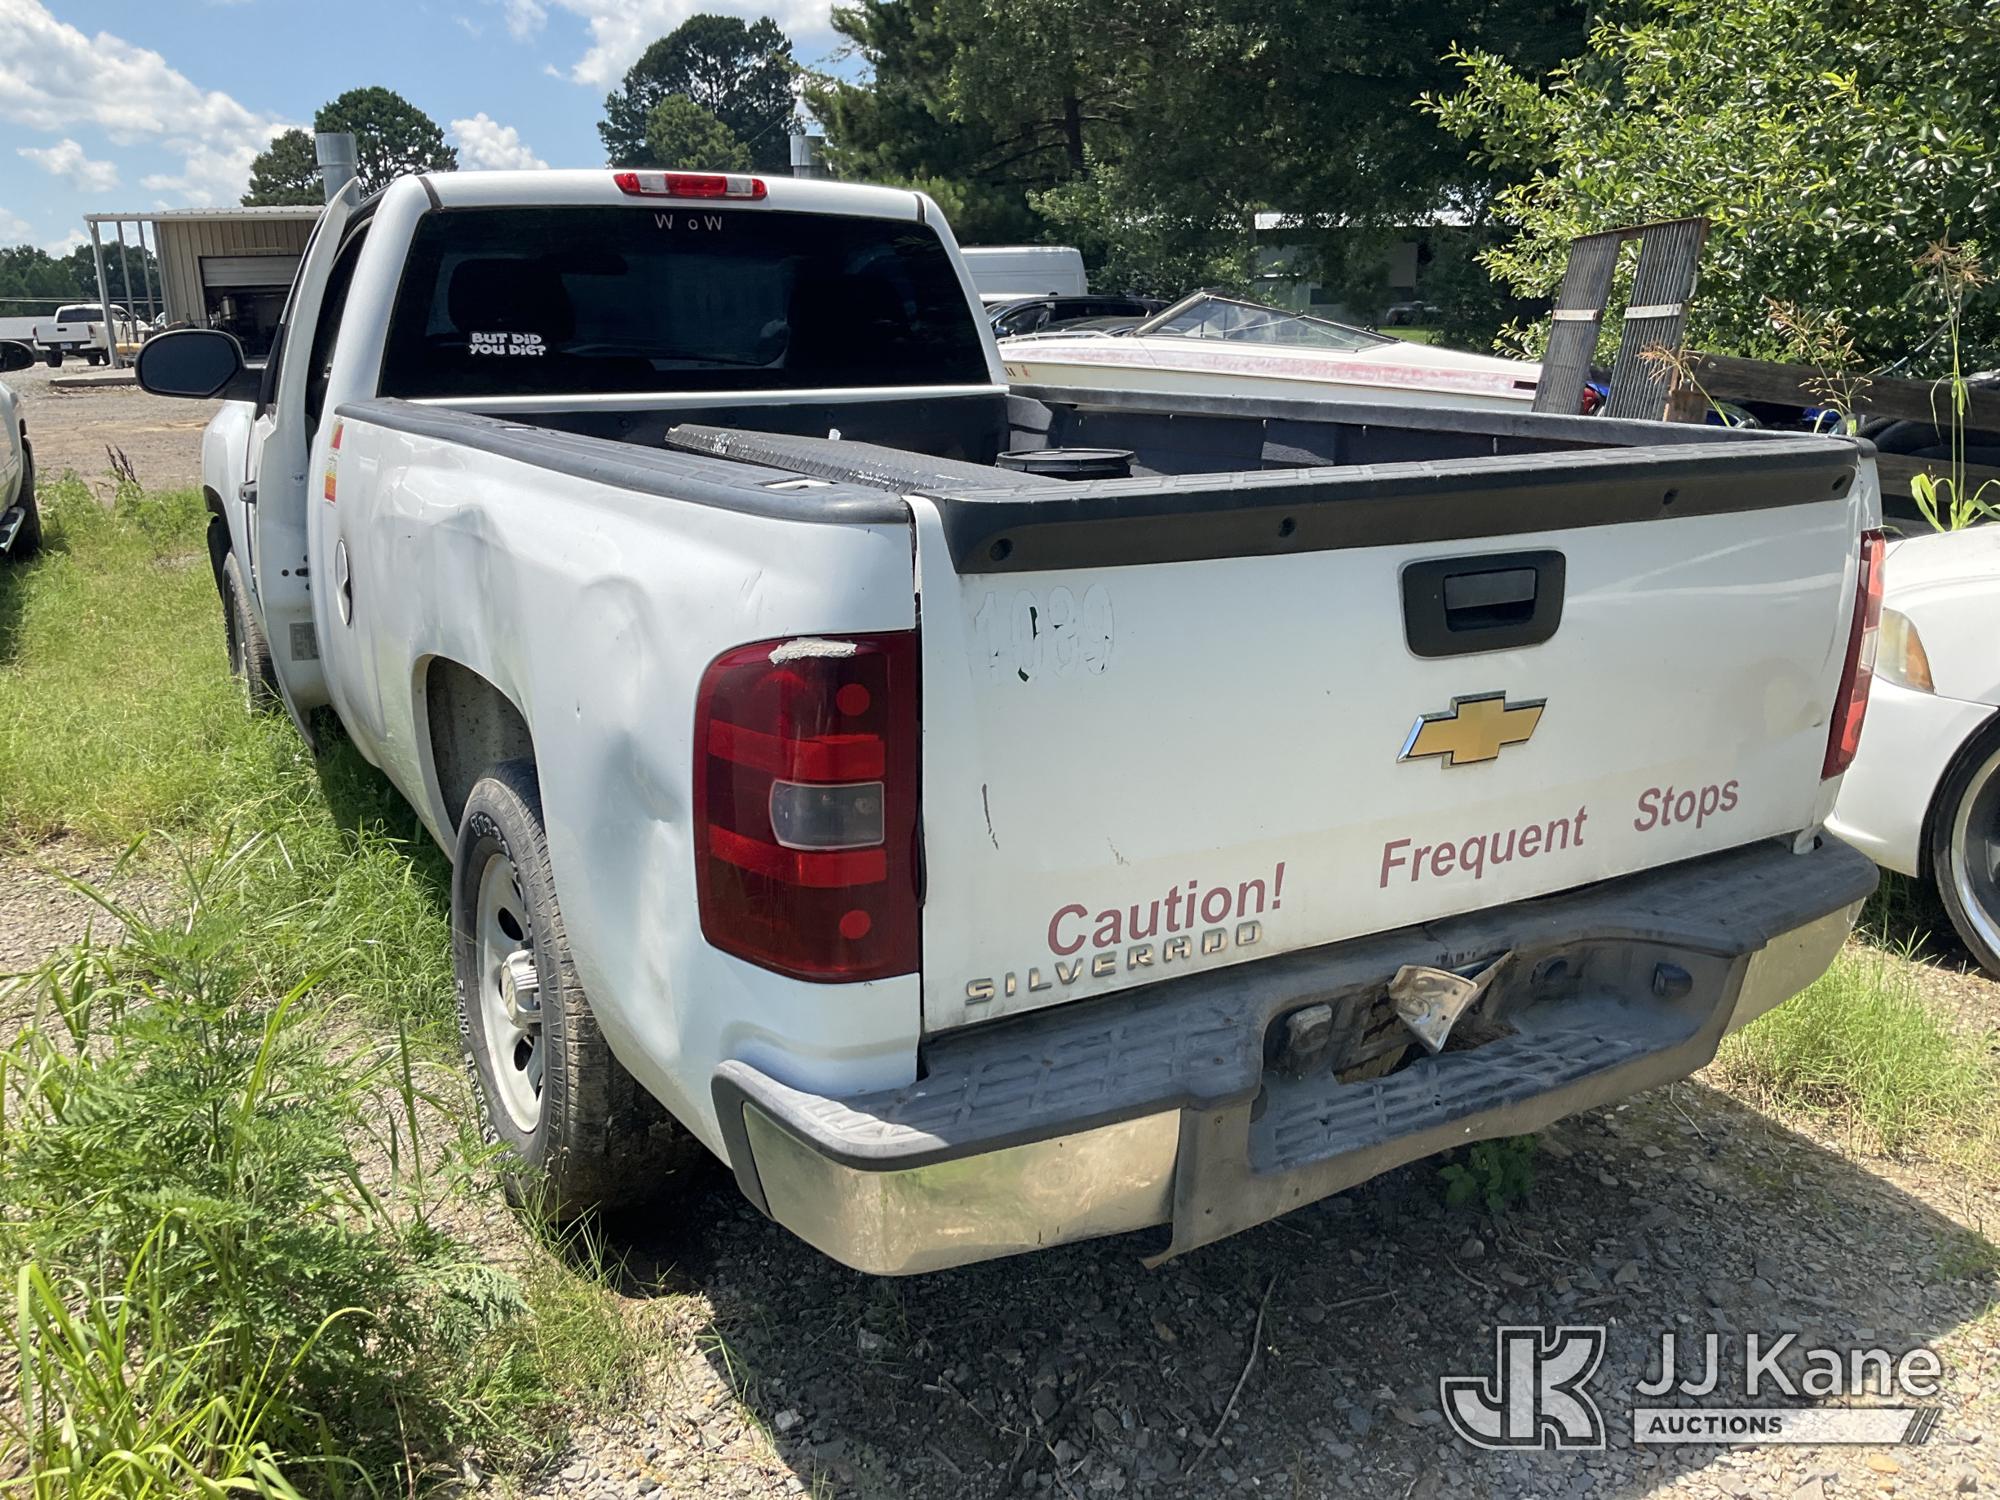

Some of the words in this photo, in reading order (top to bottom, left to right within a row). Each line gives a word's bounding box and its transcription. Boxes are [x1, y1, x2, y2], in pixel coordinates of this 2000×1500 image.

[469, 343, 506, 355] YOU
[471, 332, 508, 344] BUT
[1047, 861, 1286, 956] Caution!
[1379, 805, 1588, 889] Frequent
[1633, 779, 1740, 832] Stops
[965, 919, 1263, 1006] SILVERADO
